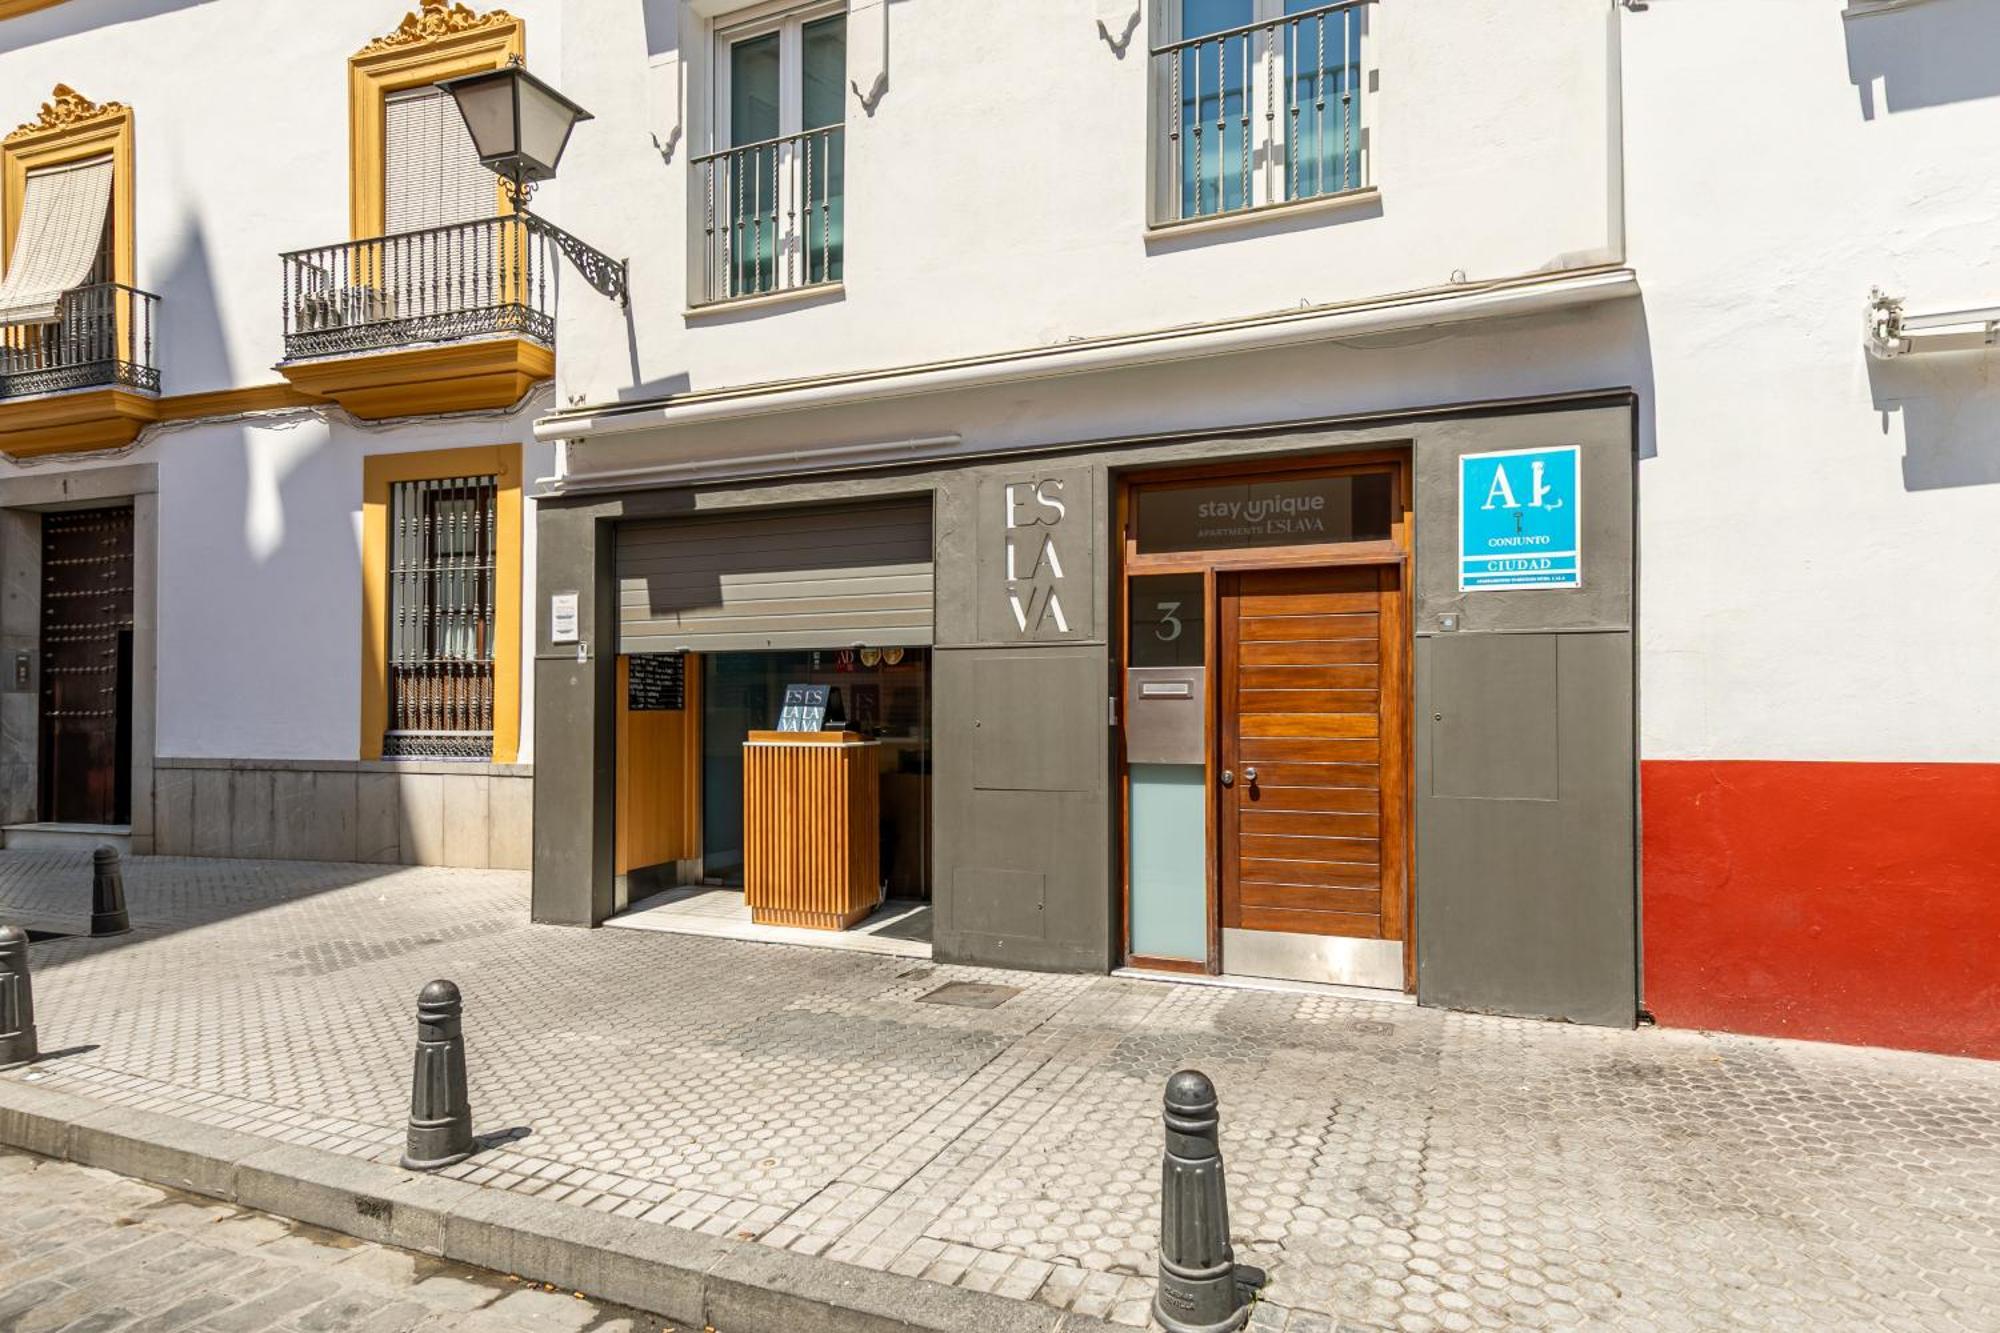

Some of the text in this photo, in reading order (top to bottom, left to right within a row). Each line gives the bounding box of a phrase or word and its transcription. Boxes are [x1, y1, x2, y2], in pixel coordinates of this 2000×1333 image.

[1005, 478, 1065, 528] ES
[1198, 494, 1325, 522] stay unique
[1267, 518, 1324, 534] ESLAVA
[1488, 535, 1551, 548] CONJUNTO
[1005, 533, 1064, 580] LA
[1487, 558, 1552, 572] CIUDAD
[1007, 585, 1069, 632] VA
[1154, 602, 1182, 641] 3
[783, 706, 800, 718] LA
[802, 706, 820, 719] LA
